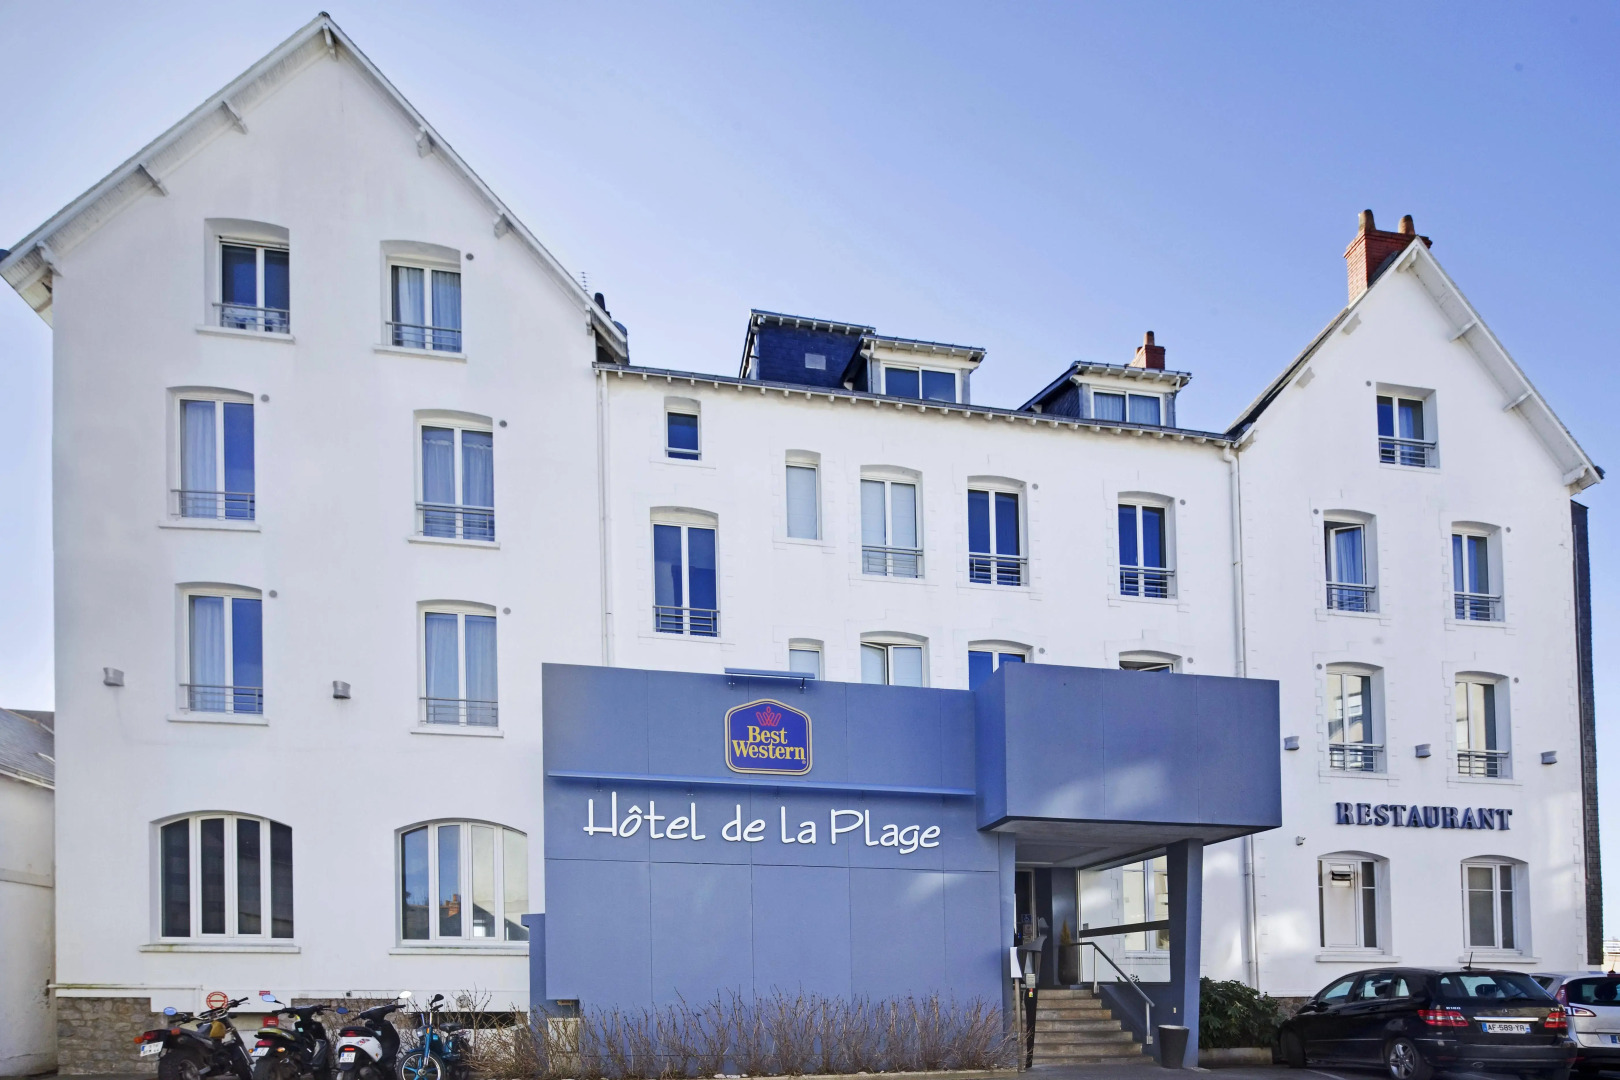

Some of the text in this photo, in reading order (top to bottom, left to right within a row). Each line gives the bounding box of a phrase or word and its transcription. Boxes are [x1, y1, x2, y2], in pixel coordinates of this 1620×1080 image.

[747, 725, 788, 745] Best
[732, 739, 806, 760] Western
[583, 791, 706, 842] Hôtel
[721, 804, 766, 843] de
[830, 808, 941, 855] Plage
[1335, 802, 1513, 831] RESTAURANT
